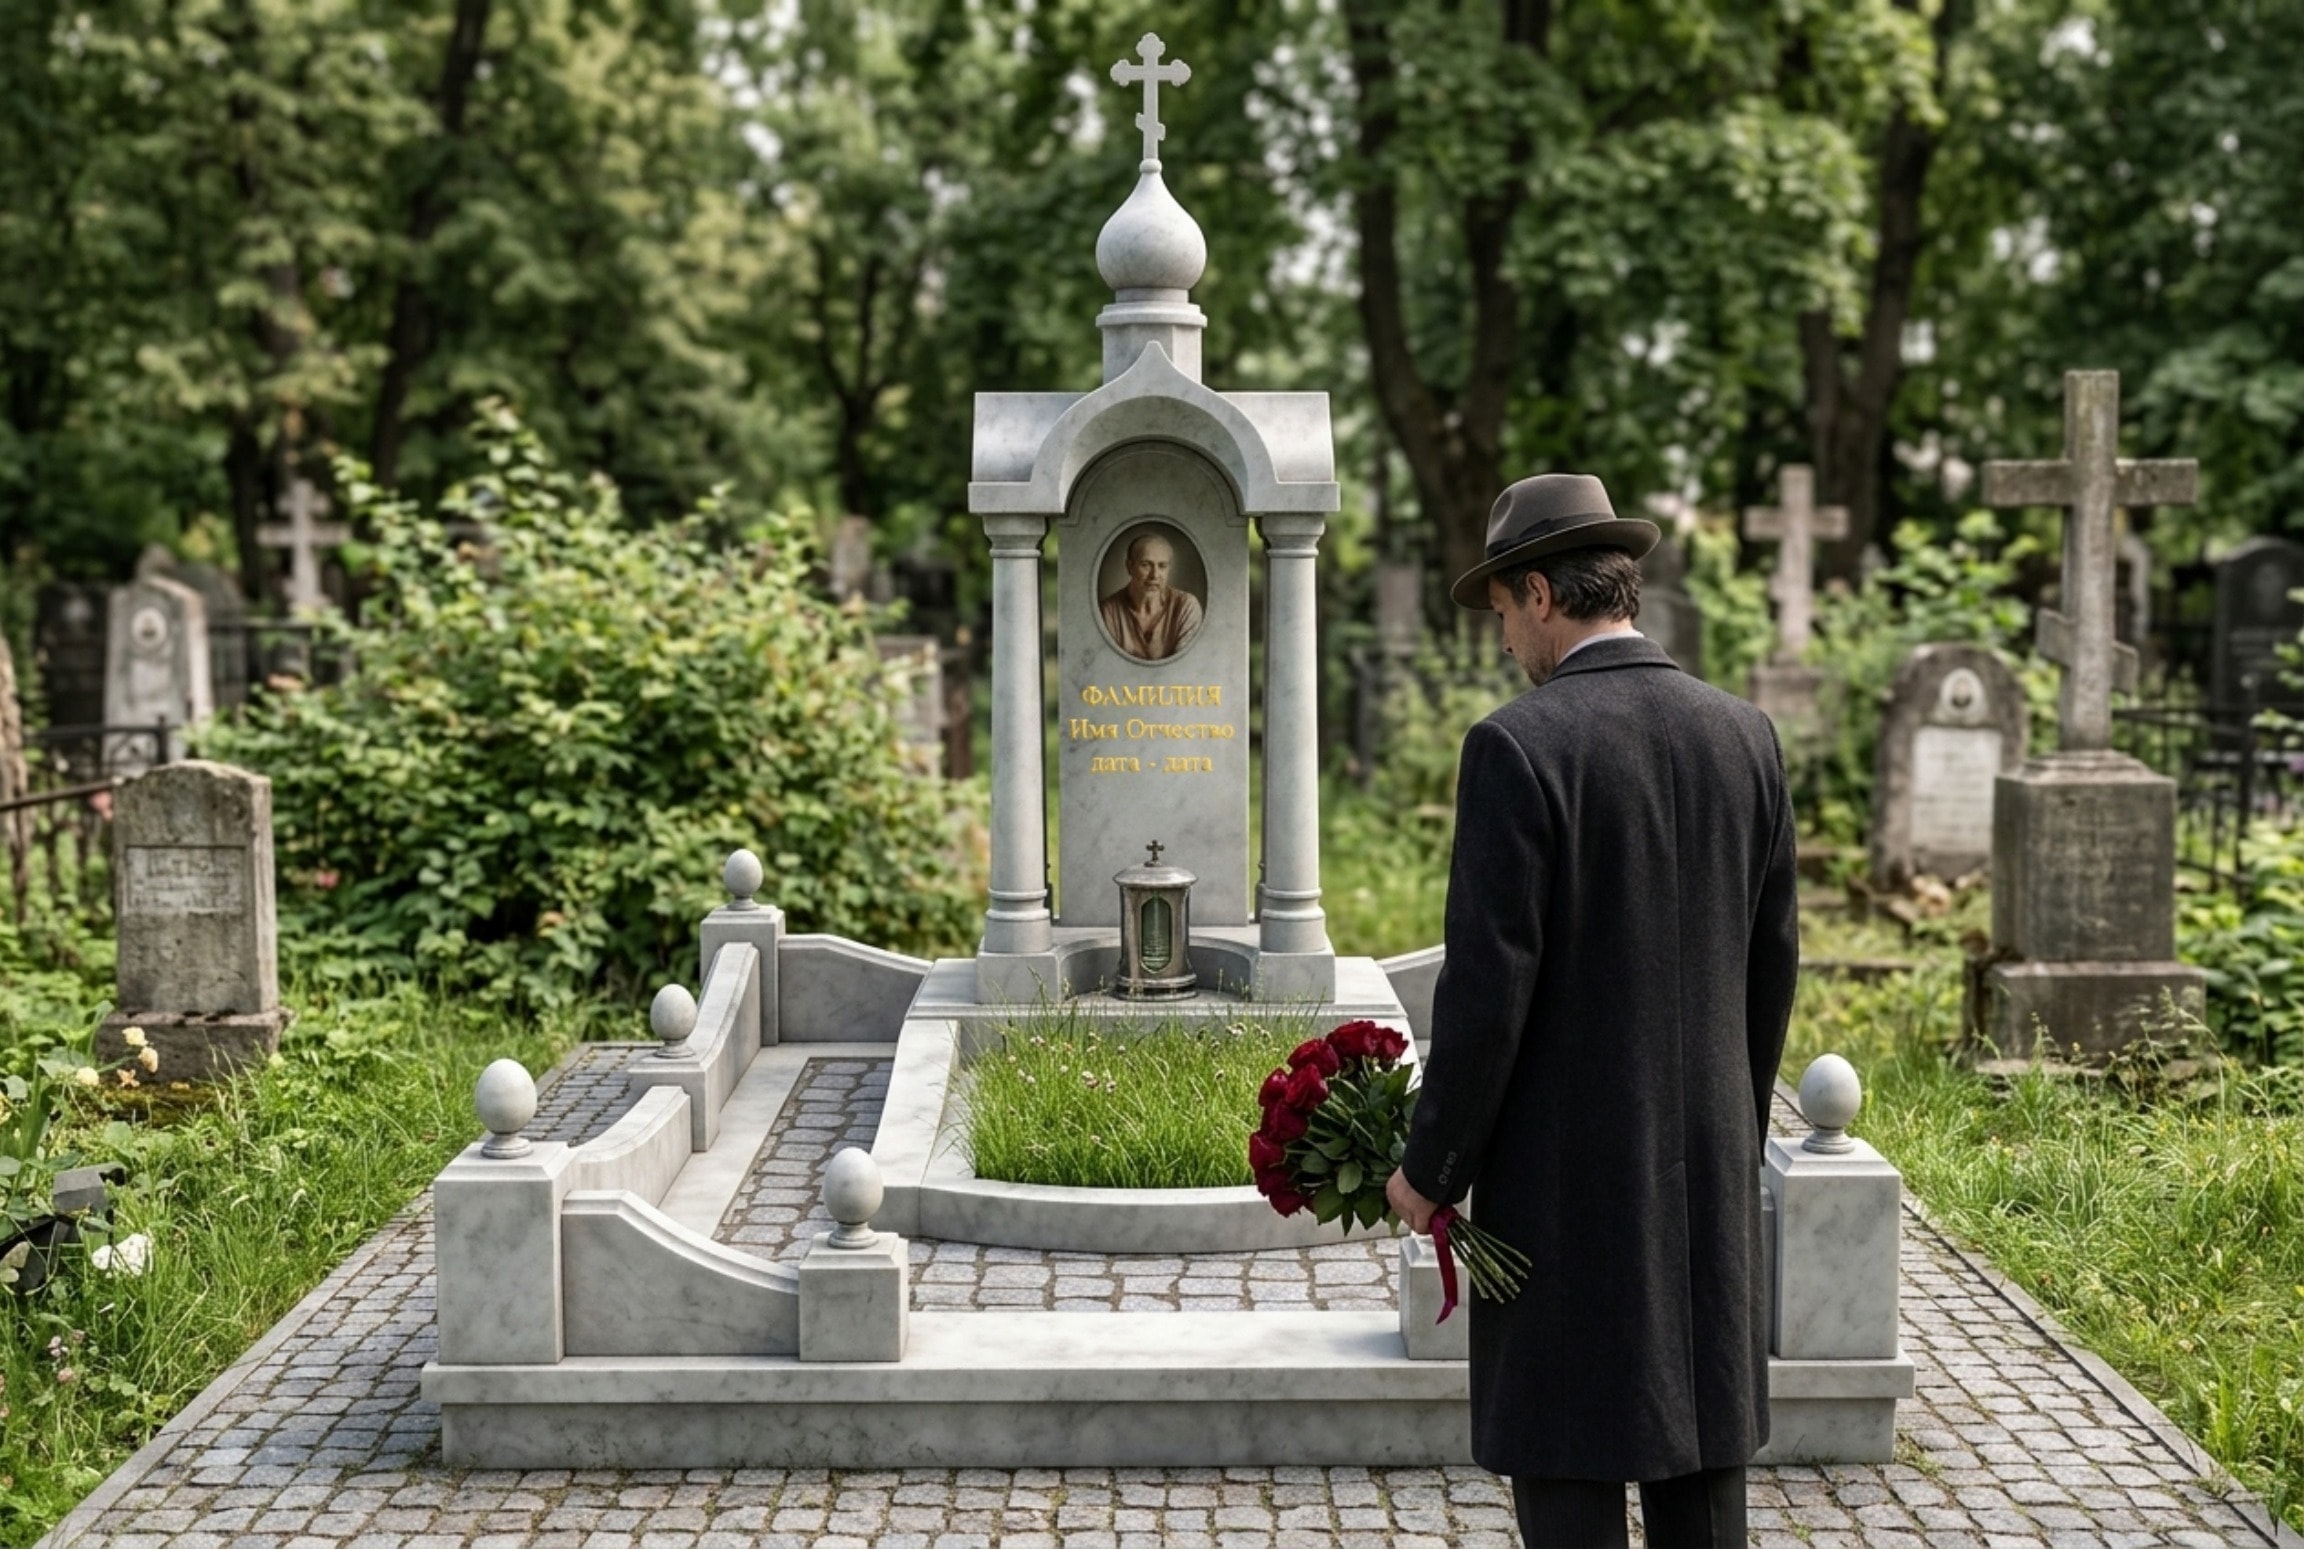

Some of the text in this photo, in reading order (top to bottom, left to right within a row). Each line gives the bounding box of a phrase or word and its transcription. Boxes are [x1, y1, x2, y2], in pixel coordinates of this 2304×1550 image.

[1080, 685, 1221, 706] ФАМИЛИЯ
[1069, 718, 1235, 739] Имя Отчество
[1091, 756, 1140, 773] дата
[1163, 756, 1213, 773] дата
